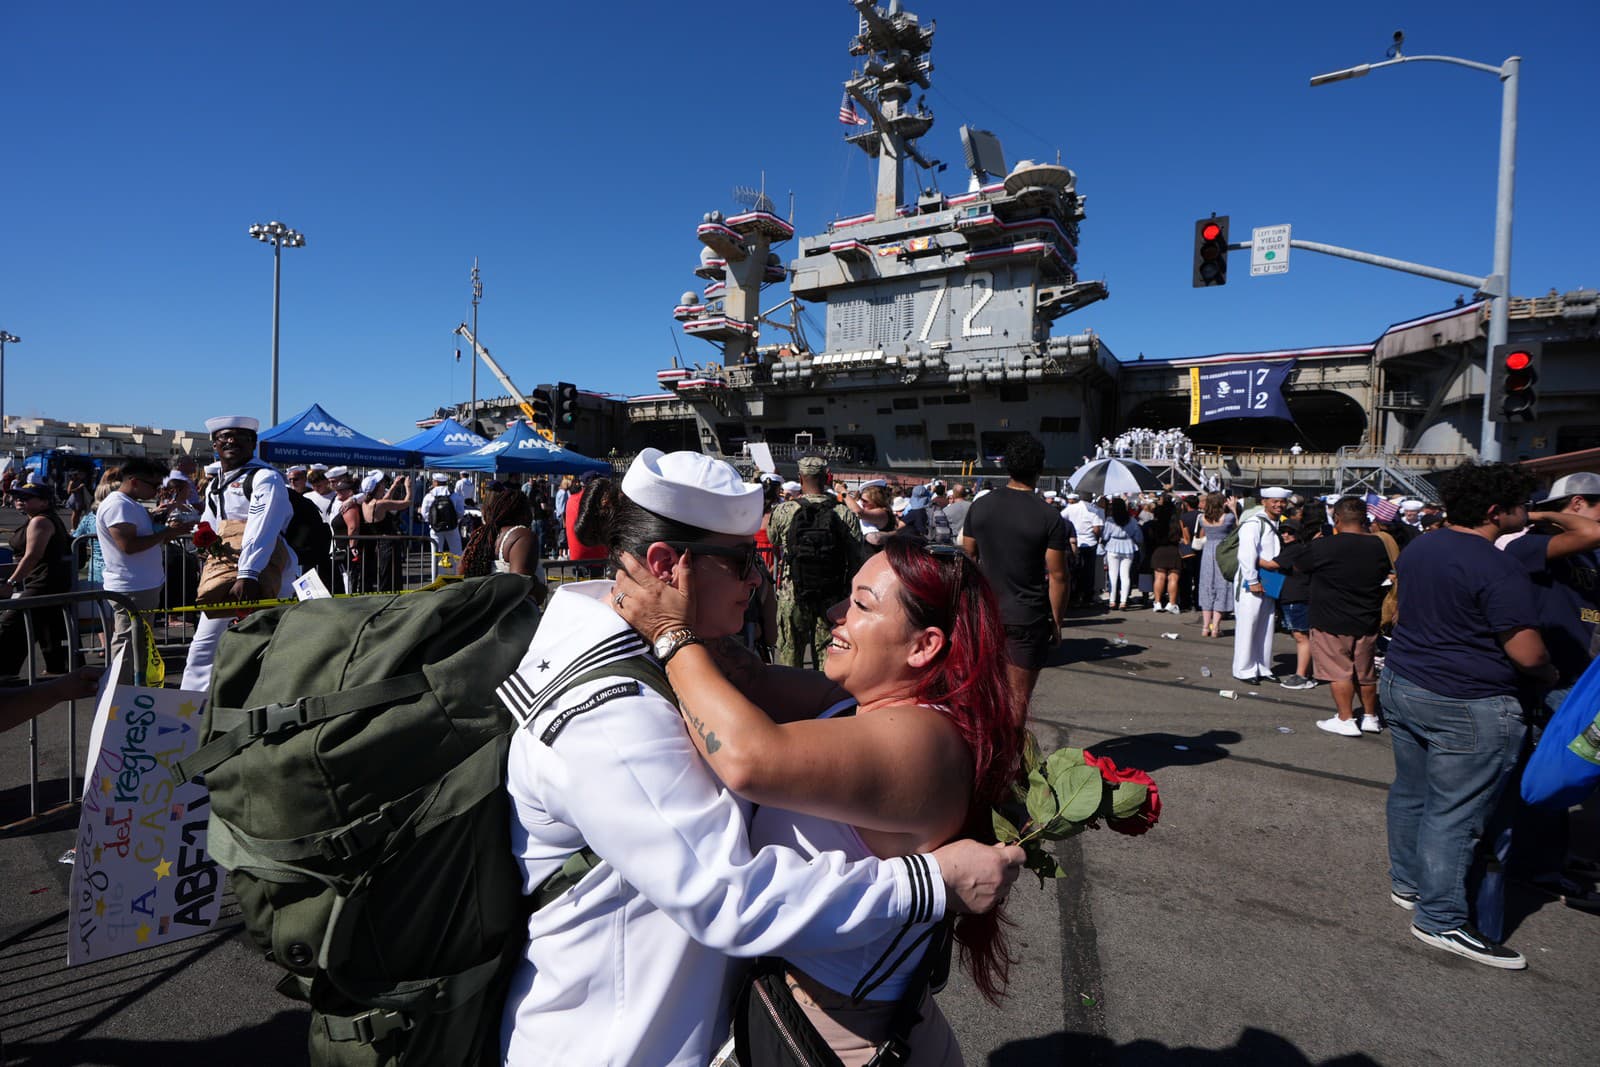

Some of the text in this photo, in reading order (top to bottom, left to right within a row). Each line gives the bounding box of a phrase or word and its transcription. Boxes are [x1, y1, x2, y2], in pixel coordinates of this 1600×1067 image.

[1260, 235, 1283, 244] YIELD
[918, 272, 994, 342] 72
[1256, 368, 1270, 386] 7
[1254, 392, 1269, 409] 2
[274, 447, 398, 463] MWR Community Recreation
[549, 685, 628, 733] USS ABRAHAM LINCOLN
[131, 886, 157, 919] A
